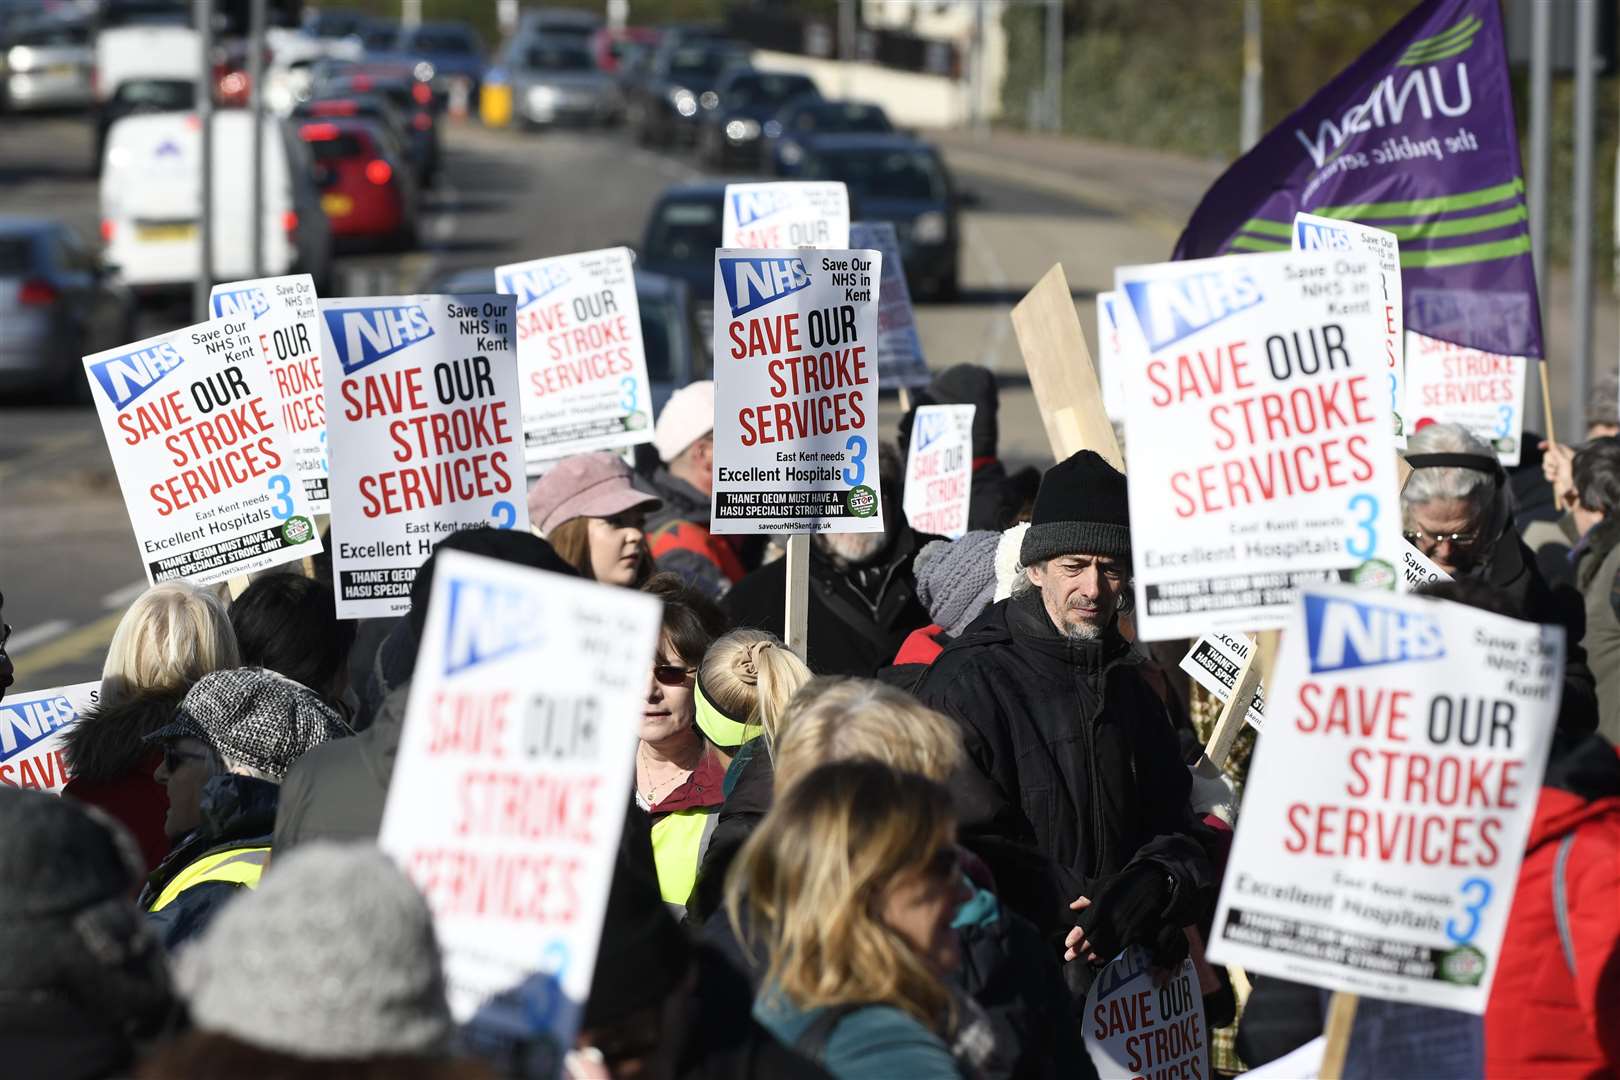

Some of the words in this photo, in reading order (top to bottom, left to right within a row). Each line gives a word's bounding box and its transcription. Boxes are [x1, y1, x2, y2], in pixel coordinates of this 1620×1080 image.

[789, 219, 830, 245] OUR
[735, 259, 807, 308] NHS
[822, 258, 848, 271] Save
[851, 258, 871, 270] Our
[832, 273, 856, 286] NHS
[860, 272, 871, 285] in
[220, 288, 269, 319] NHS
[276, 284, 294, 296] Save
[296, 282, 310, 294] Our
[285, 295, 302, 307] NHS
[306, 295, 312, 305] in
[845, 288, 871, 301] Kent
[297, 308, 315, 319] Kent
[447, 304, 478, 318] Save
[482, 302, 507, 317] Our
[460, 320, 489, 335] NHS
[495, 319, 507, 334] in
[517, 302, 569, 340] SAVE
[572, 289, 618, 323] OUR
[1147, 271, 1258, 346] NHS
[192, 330, 220, 344] Save
[224, 321, 247, 335] Our
[206, 337, 234, 355] NHS
[239, 334, 250, 345] in
[273, 323, 311, 361] OUR
[343, 308, 430, 366] NHS
[477, 337, 508, 351] Kent
[547, 315, 632, 361] STROKE
[729, 313, 801, 360] SAVE
[808, 305, 857, 348] OUR
[105, 343, 180, 400] NHS
[225, 347, 255, 363] Kent
[530, 346, 633, 397] SERVICES
[768, 346, 869, 398] STROKE
[1146, 341, 1255, 407] SAVE
[1265, 324, 1351, 381] OUR
[1443, 355, 1515, 377] STROKE
[269, 357, 324, 399] ROKE
[341, 367, 428, 421] SAVE
[434, 356, 495, 405] OUR
[621, 377, 637, 413] 3
[1423, 378, 1514, 406] SERVICES
[117, 390, 191, 445] SAVE
[190, 366, 251, 414] OUR
[738, 390, 865, 447] SERVICES
[1209, 376, 1376, 451] STROKE
[1496, 404, 1514, 437] 3
[165, 397, 274, 467] STROKE
[389, 401, 512, 462] STROKE
[296, 458, 320, 471] pitals
[719, 467, 780, 482] Excellent
[786, 466, 842, 484] Hospitals
[777, 452, 796, 462] East
[799, 451, 818, 461] Kent
[820, 451, 845, 461] needs
[842, 435, 868, 486] 3
[150, 437, 281, 516] SERVICES
[359, 451, 512, 518] SERVICES
[1170, 435, 1375, 518] SERVICES
[195, 508, 215, 520] East
[217, 502, 240, 514] Kent
[242, 493, 270, 507] needs
[267, 474, 294, 520] 3
[720, 505, 744, 516] HASU
[745, 505, 793, 516] SPECIALIST
[795, 505, 824, 515] STROKE
[825, 504, 844, 515] UNIT
[726, 493, 760, 504] THANET
[762, 493, 786, 504] QEQM
[788, 493, 809, 503] MUST
[811, 492, 831, 503] HAVE
[832, 493, 838, 503] A
[144, 526, 206, 553] Excellent
[209, 508, 271, 535] Hospitals
[406, 522, 430, 533] East
[434, 521, 458, 532] Kent
[1345, 494, 1381, 561] 3
[158, 553, 192, 571] THANET
[217, 538, 242, 555] MUST
[243, 531, 268, 547] HAVE
[266, 529, 274, 539] A
[180, 554, 229, 576] SPECIALIST
[228, 545, 262, 562] STROKE
[262, 538, 282, 553] UNIT
[340, 541, 412, 559] Excellent
[1145, 542, 1236, 568] Excellent
[1245, 539, 1339, 561] Hospitals
[1403, 552, 1427, 576] Save
[345, 585, 372, 598] HASU
[374, 583, 412, 596] SPECIA
[351, 570, 389, 583] THANET
[1317, 601, 1443, 668] NHS
[1195, 652, 1218, 672] HASU
[1207, 646, 1237, 674] THANET
[0, 697, 74, 753] NHS
[1296, 682, 1412, 741] SAVE
[1427, 694, 1516, 748] OUR
[1346, 747, 1525, 810] STROKE
[1285, 803, 1503, 868] SERVICES
[1445, 877, 1493, 944] 3
[1094, 991, 1155, 1040] SAVE
[1159, 976, 1193, 1021] OUR
[1125, 1012, 1203, 1073] STROKE
